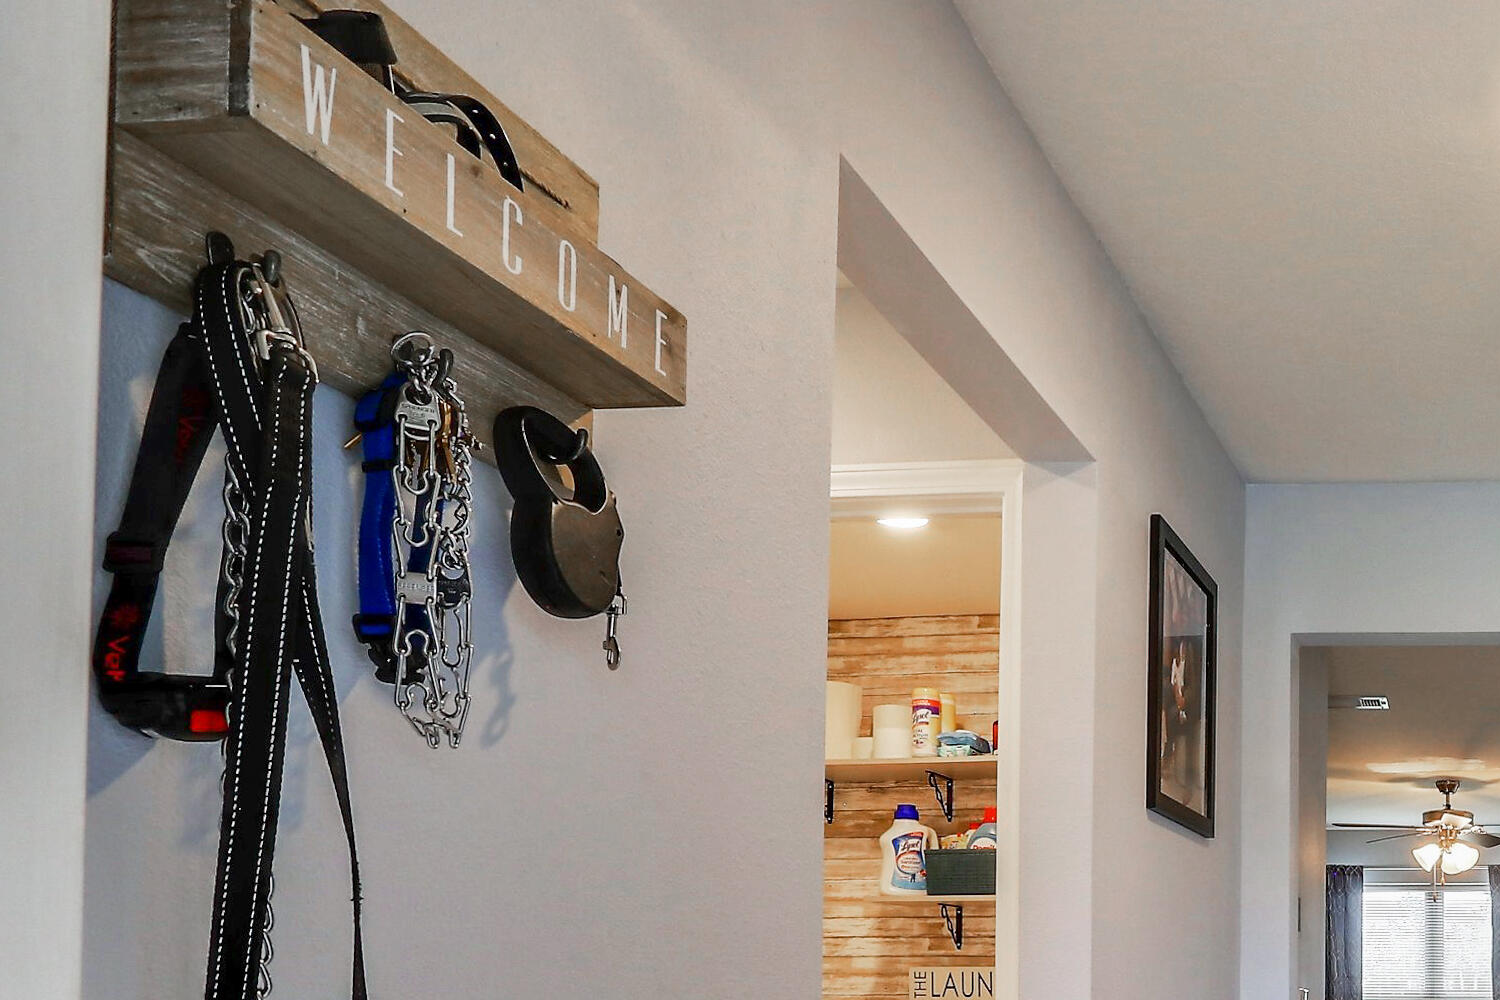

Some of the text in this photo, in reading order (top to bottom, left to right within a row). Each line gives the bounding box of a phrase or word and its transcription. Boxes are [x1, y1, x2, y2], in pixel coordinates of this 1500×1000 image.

[301, 44, 668, 376] WELCOME
[901, 841, 920, 851] Lysol
[914, 971, 993, 999] THE LAUN
